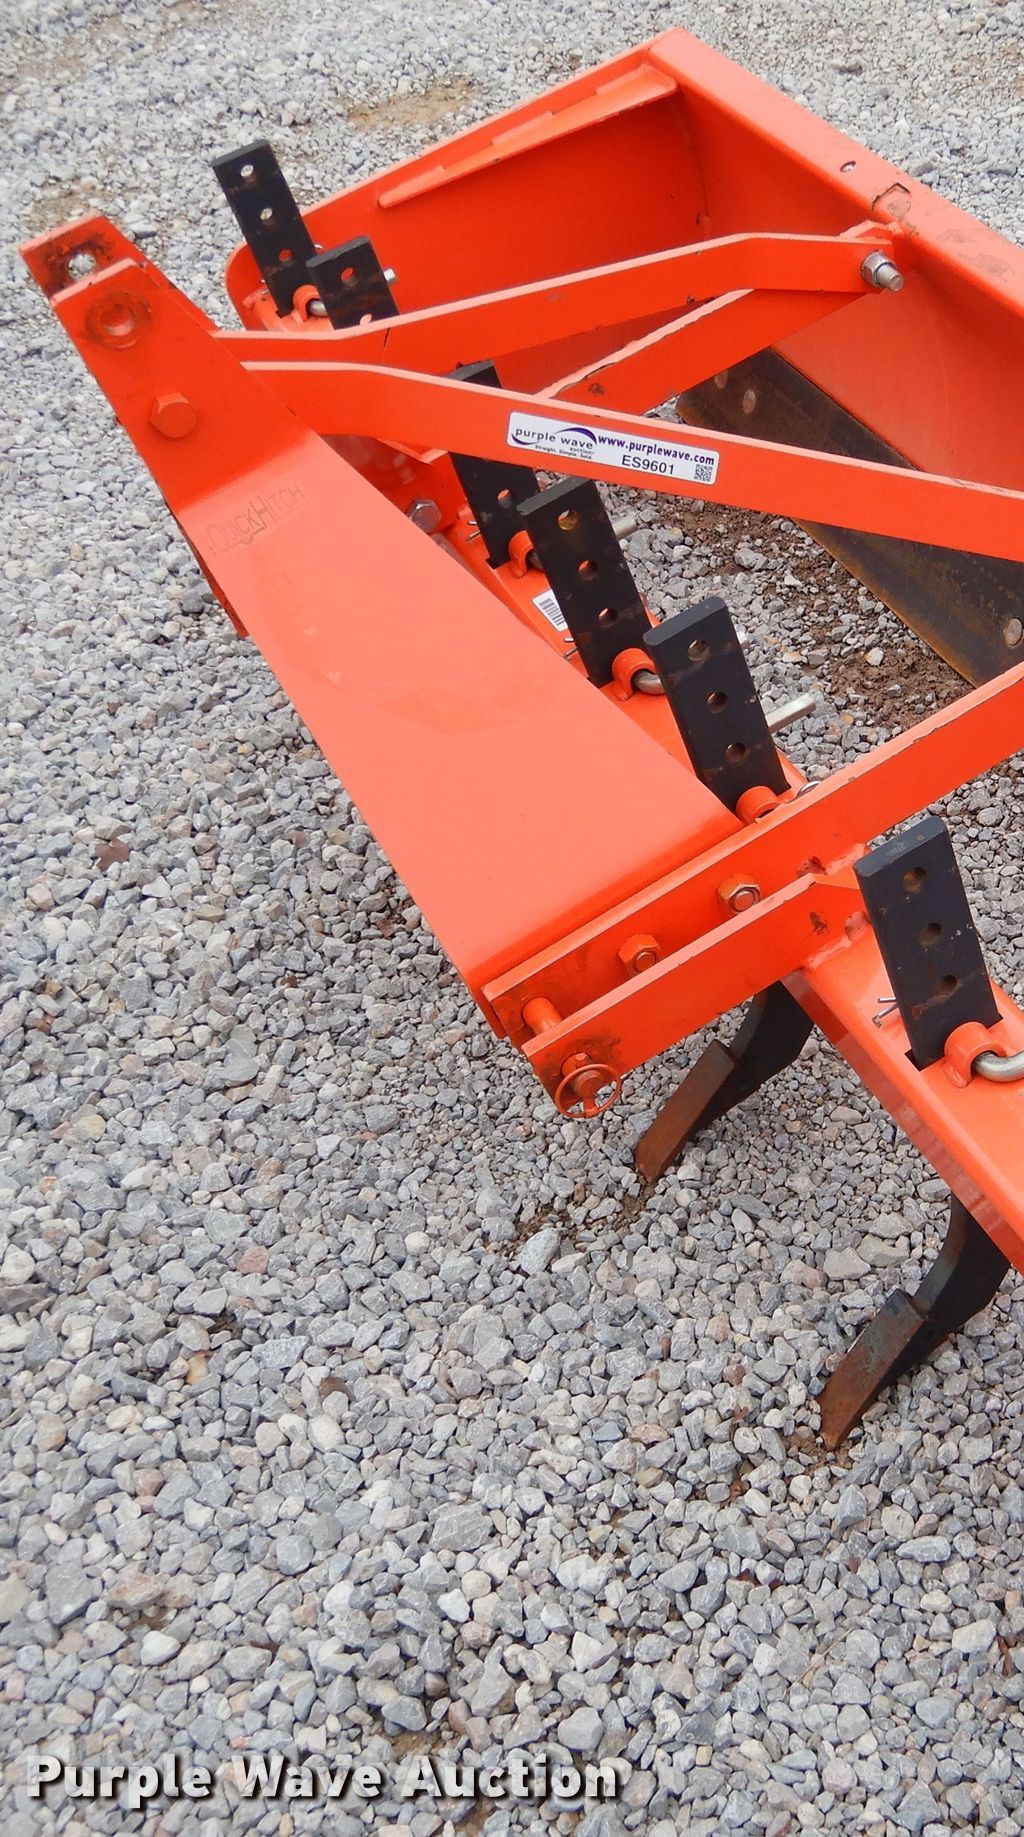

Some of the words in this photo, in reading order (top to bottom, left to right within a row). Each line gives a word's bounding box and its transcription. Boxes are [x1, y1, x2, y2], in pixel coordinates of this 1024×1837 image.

[515, 428, 556, 442] purple
[561, 437, 593, 450] wave
[598, 435, 715, 466] www.purplewave.com
[621, 454, 675, 475] ES9601
